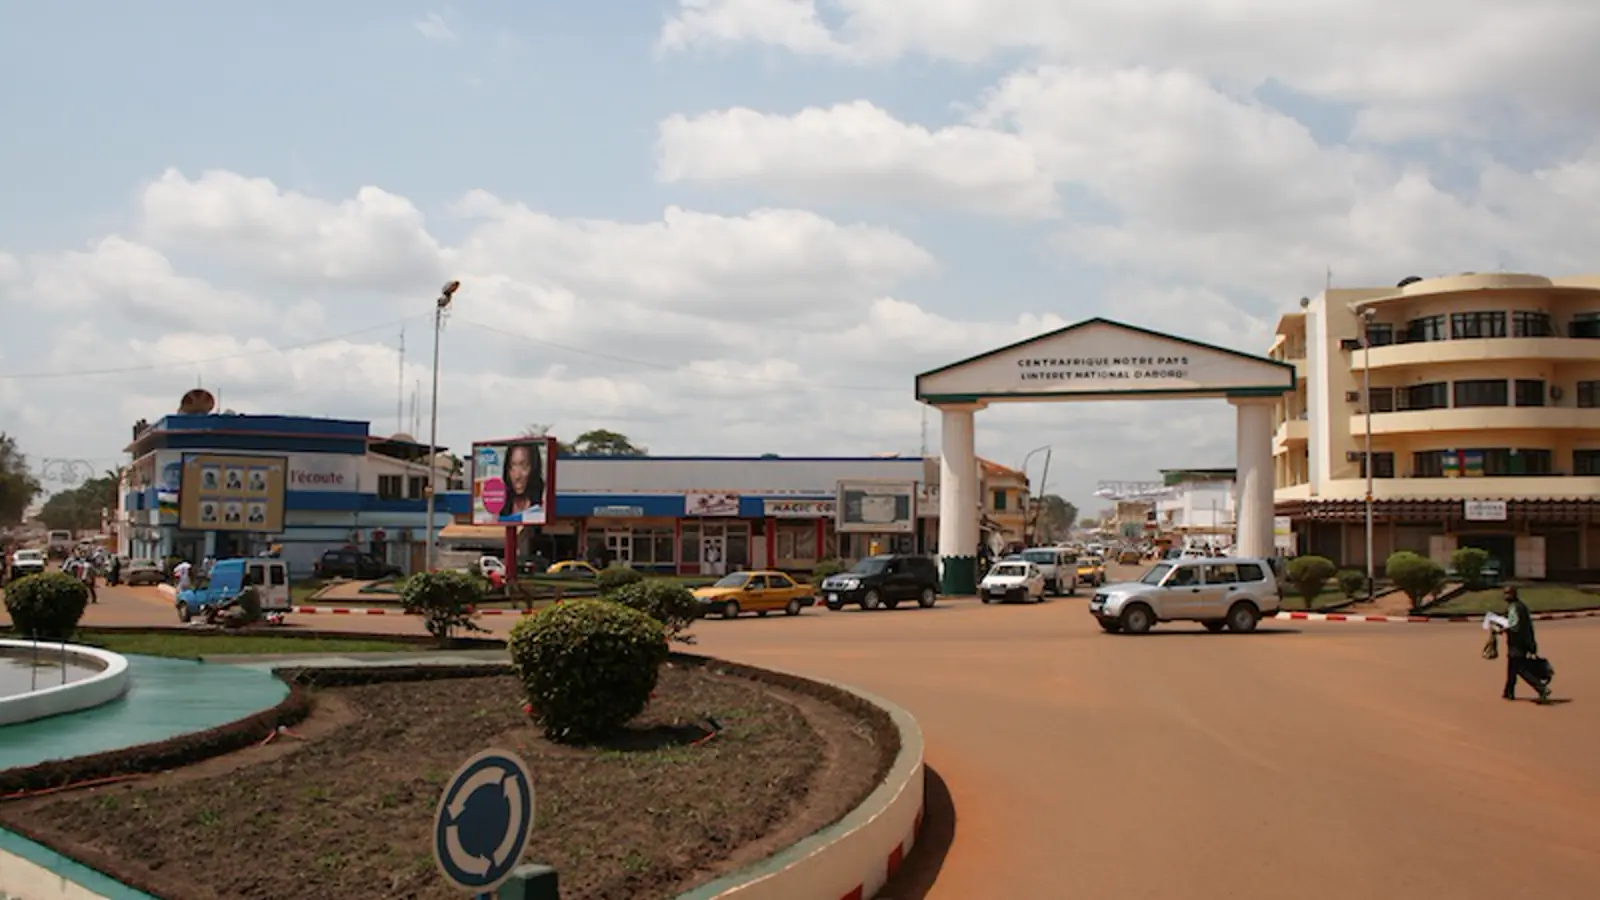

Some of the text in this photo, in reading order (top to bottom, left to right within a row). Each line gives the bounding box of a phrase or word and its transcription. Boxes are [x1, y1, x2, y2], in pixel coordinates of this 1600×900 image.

[1017, 356, 1189, 367] CENTRAFRIQUE NOTRE PAYS
[1075, 371, 1130, 380] NATIONAL
